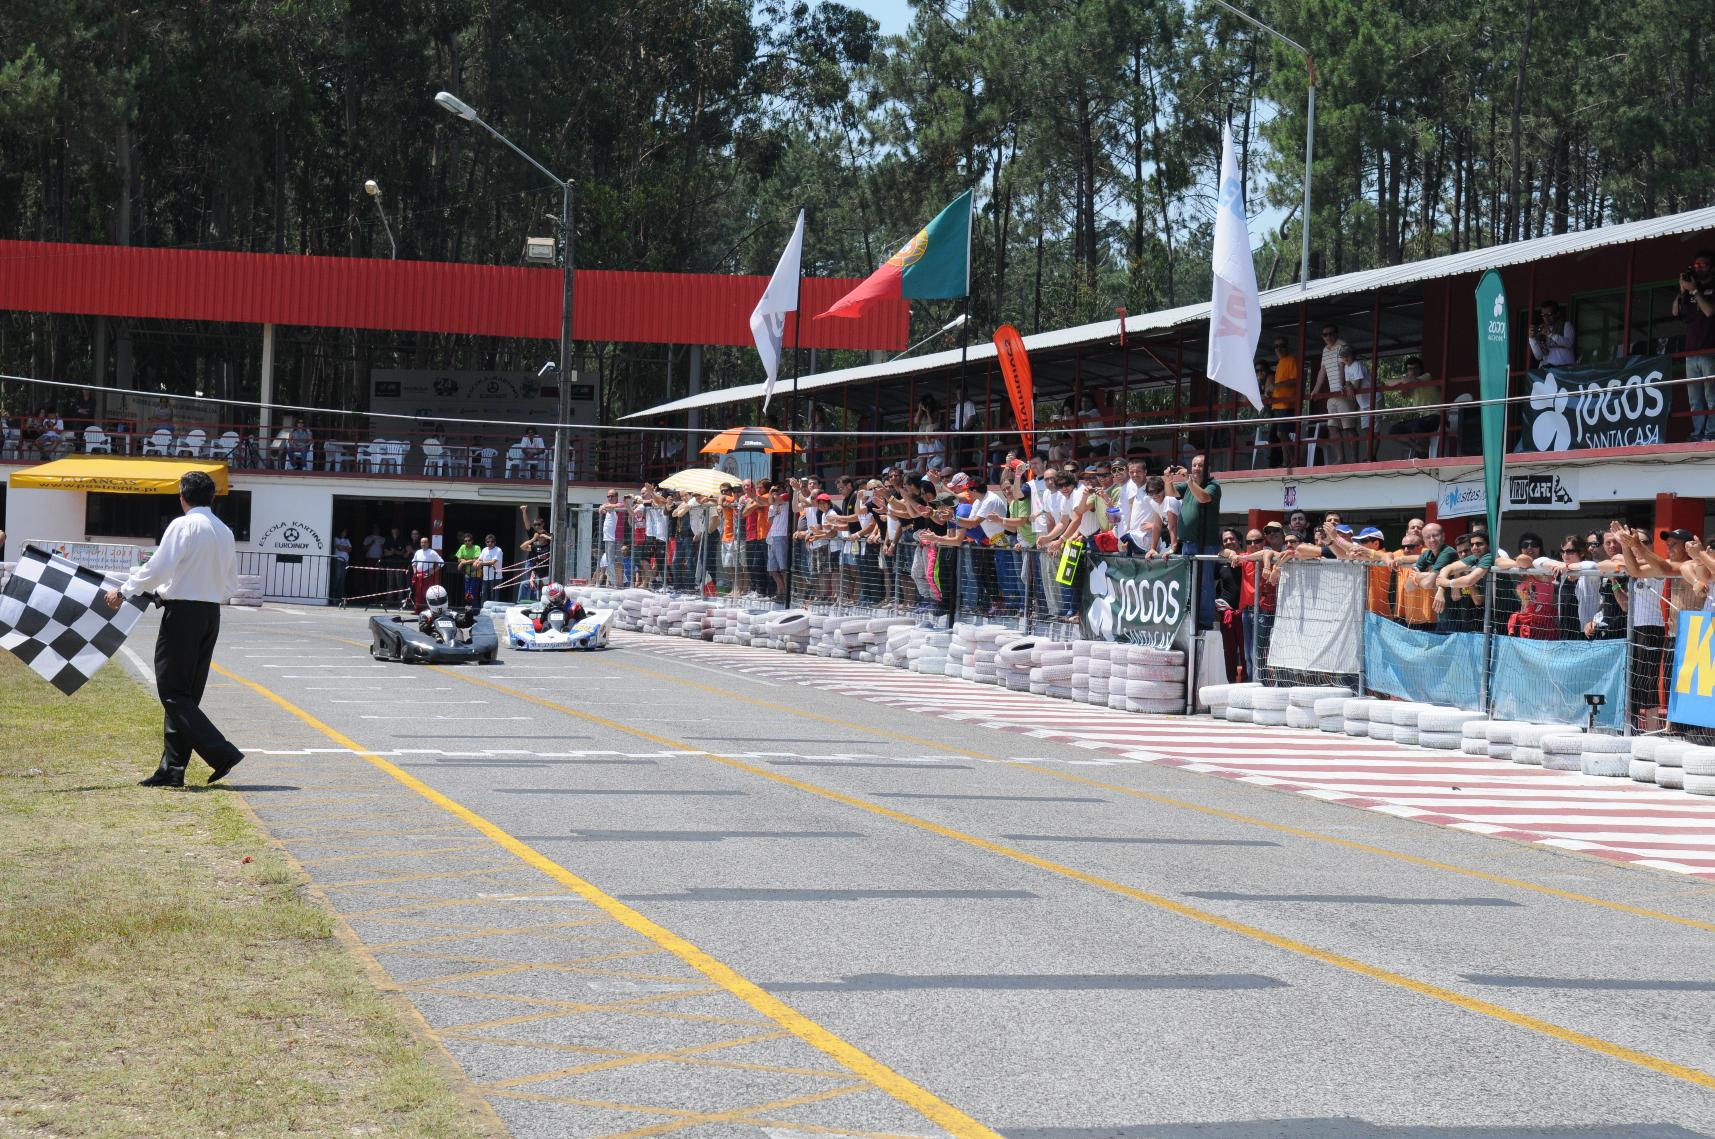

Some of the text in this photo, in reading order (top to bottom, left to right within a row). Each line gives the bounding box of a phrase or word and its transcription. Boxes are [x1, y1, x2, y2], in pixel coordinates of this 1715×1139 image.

[1575, 370, 1664, 443] JOGOS
[258, 520, 324, 550] ESCOLA KARTING
[1116, 578, 1180, 635] JOGOS
